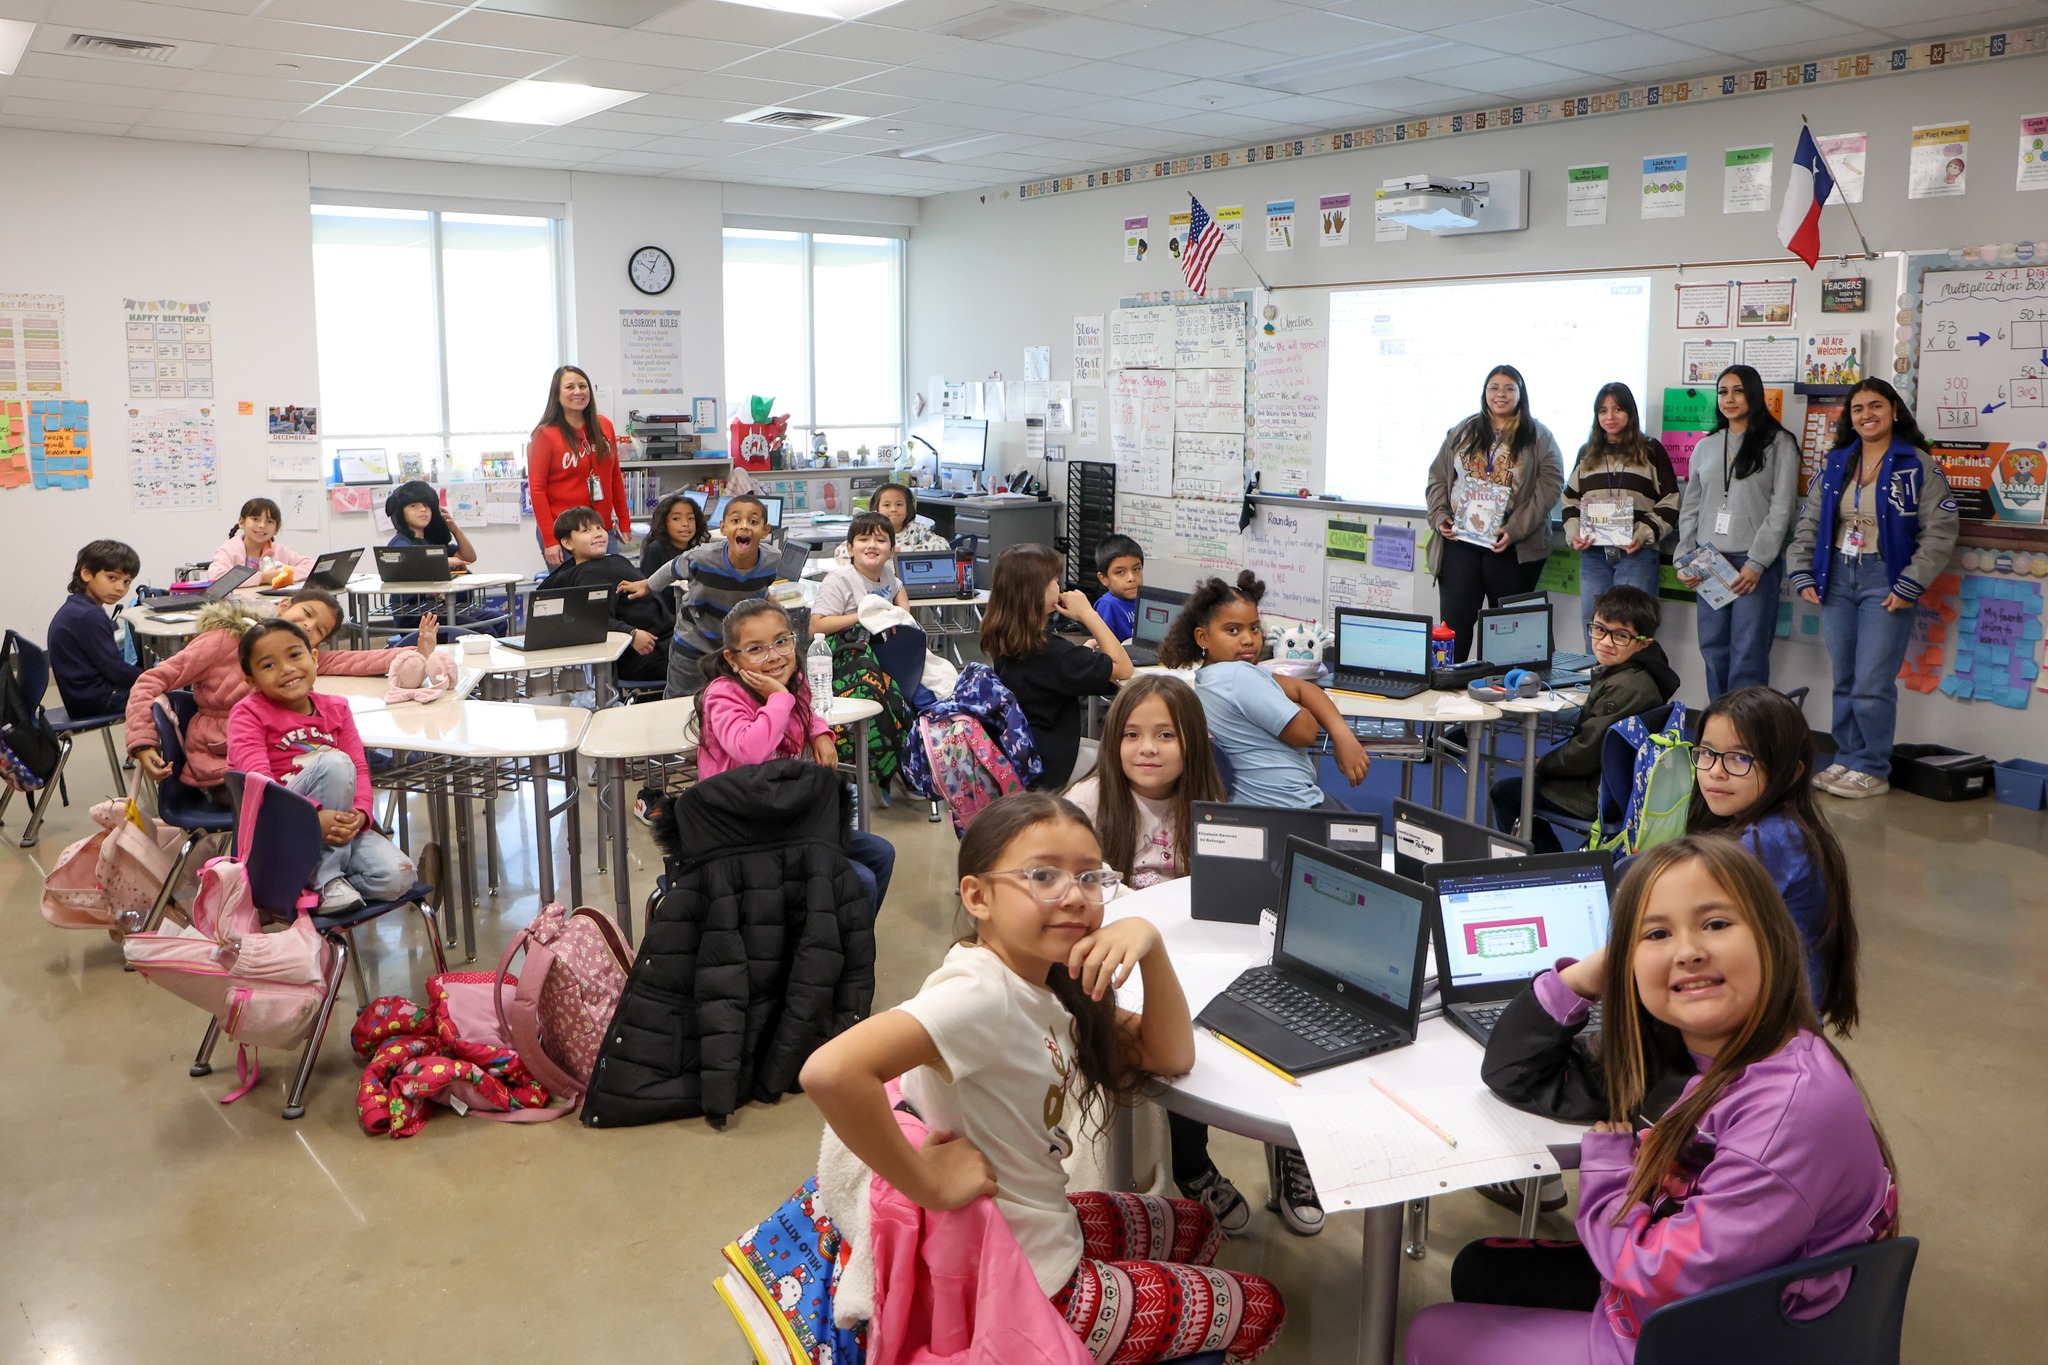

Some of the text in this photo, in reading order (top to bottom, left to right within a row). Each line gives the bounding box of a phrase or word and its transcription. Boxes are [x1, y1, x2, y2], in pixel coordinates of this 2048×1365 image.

[2028, 119, 2043, 127] Look
[1941, 128, 1966, 138] Families
[1985, 269, 2018, 279] 2 1
[1824, 281, 1862, 290] TEACHERS
[1941, 279, 2022, 297] Multiplication:
[2020, 309, 2034, 320] 50
[623, 319, 678, 327] CLASSROOM RULES
[1280, 314, 1313, 331] Objectives
[1937, 321, 1957, 334] 53
[1076, 323, 1101, 335] Slow
[1998, 327, 2005, 339] 6
[1078, 336, 1099, 346] DOWN
[1821, 337, 1843, 345] All Are
[1948, 336, 1955, 349] 6
[1817, 347, 1847, 355] Welcome
[1075, 357, 1101, 368] Start
[1077, 369, 1100, 379] AGAIN
[2021, 366, 2036, 377] 50
[1944, 377, 1968, 391] 300
[1258, 391, 1275, 399] Science
[1998, 384, 2006, 398] 6
[2017, 387, 2037, 397] 300
[1947, 410, 1969, 424] 318
[878, 449, 892, 458] BIG
[2000, 483, 2045, 493] RAMAGE
[1466, 491, 1503, 501] Mitten
[1268, 512, 1297, 533] Rounding
[1300, 538, 1313, 547] value
[1330, 532, 1365, 549] CHAMPS
[1298, 564, 1305, 573] 10
[1984, 608, 2023, 623] My favorite
[1981, 621, 2013, 634] thing to
[777, 1213, 822, 1272] HELLO KITTY
